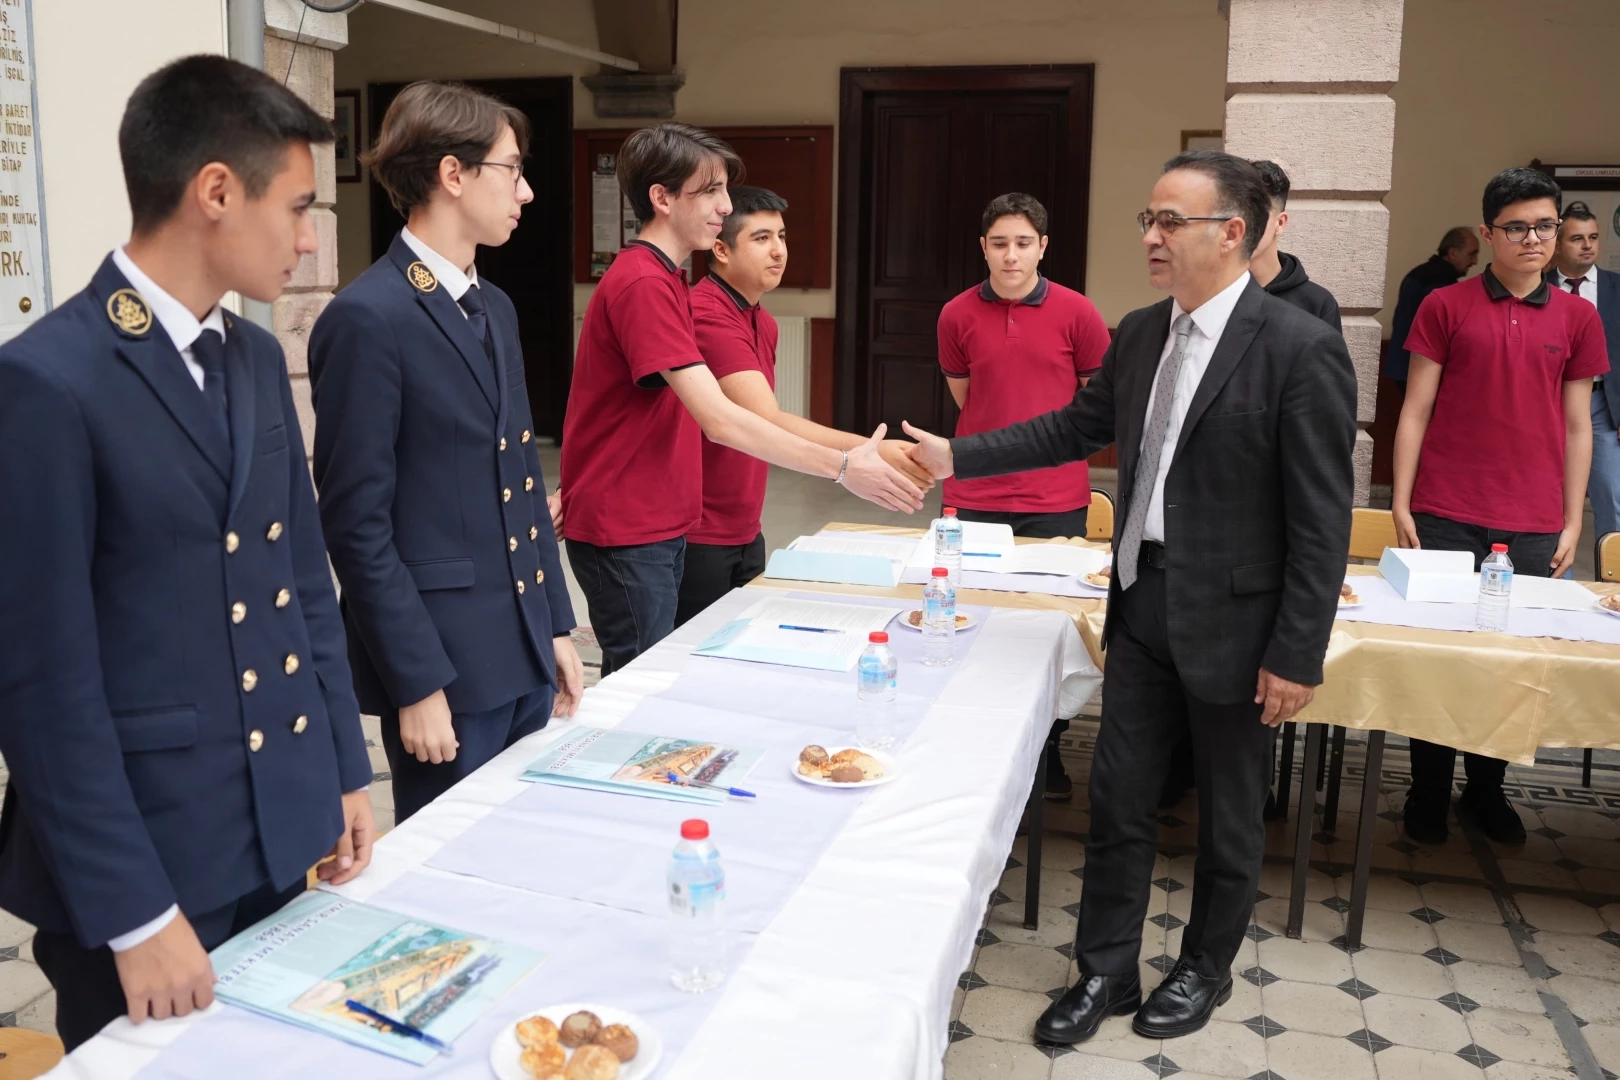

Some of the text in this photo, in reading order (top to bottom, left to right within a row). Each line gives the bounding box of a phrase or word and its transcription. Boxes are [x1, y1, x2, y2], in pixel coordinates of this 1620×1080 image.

[0, 25, 16, 42] ZİZ
[5, 64, 25, 81] İŞGAL
[5, 104, 29, 119] GAFLET
[5, 119, 32, 137] İKTİDAR
[0, 138, 26, 155] RİYLE
[1, 156, 21, 172] BİTAP
[12, 212, 37, 227] MUHTAÇ
